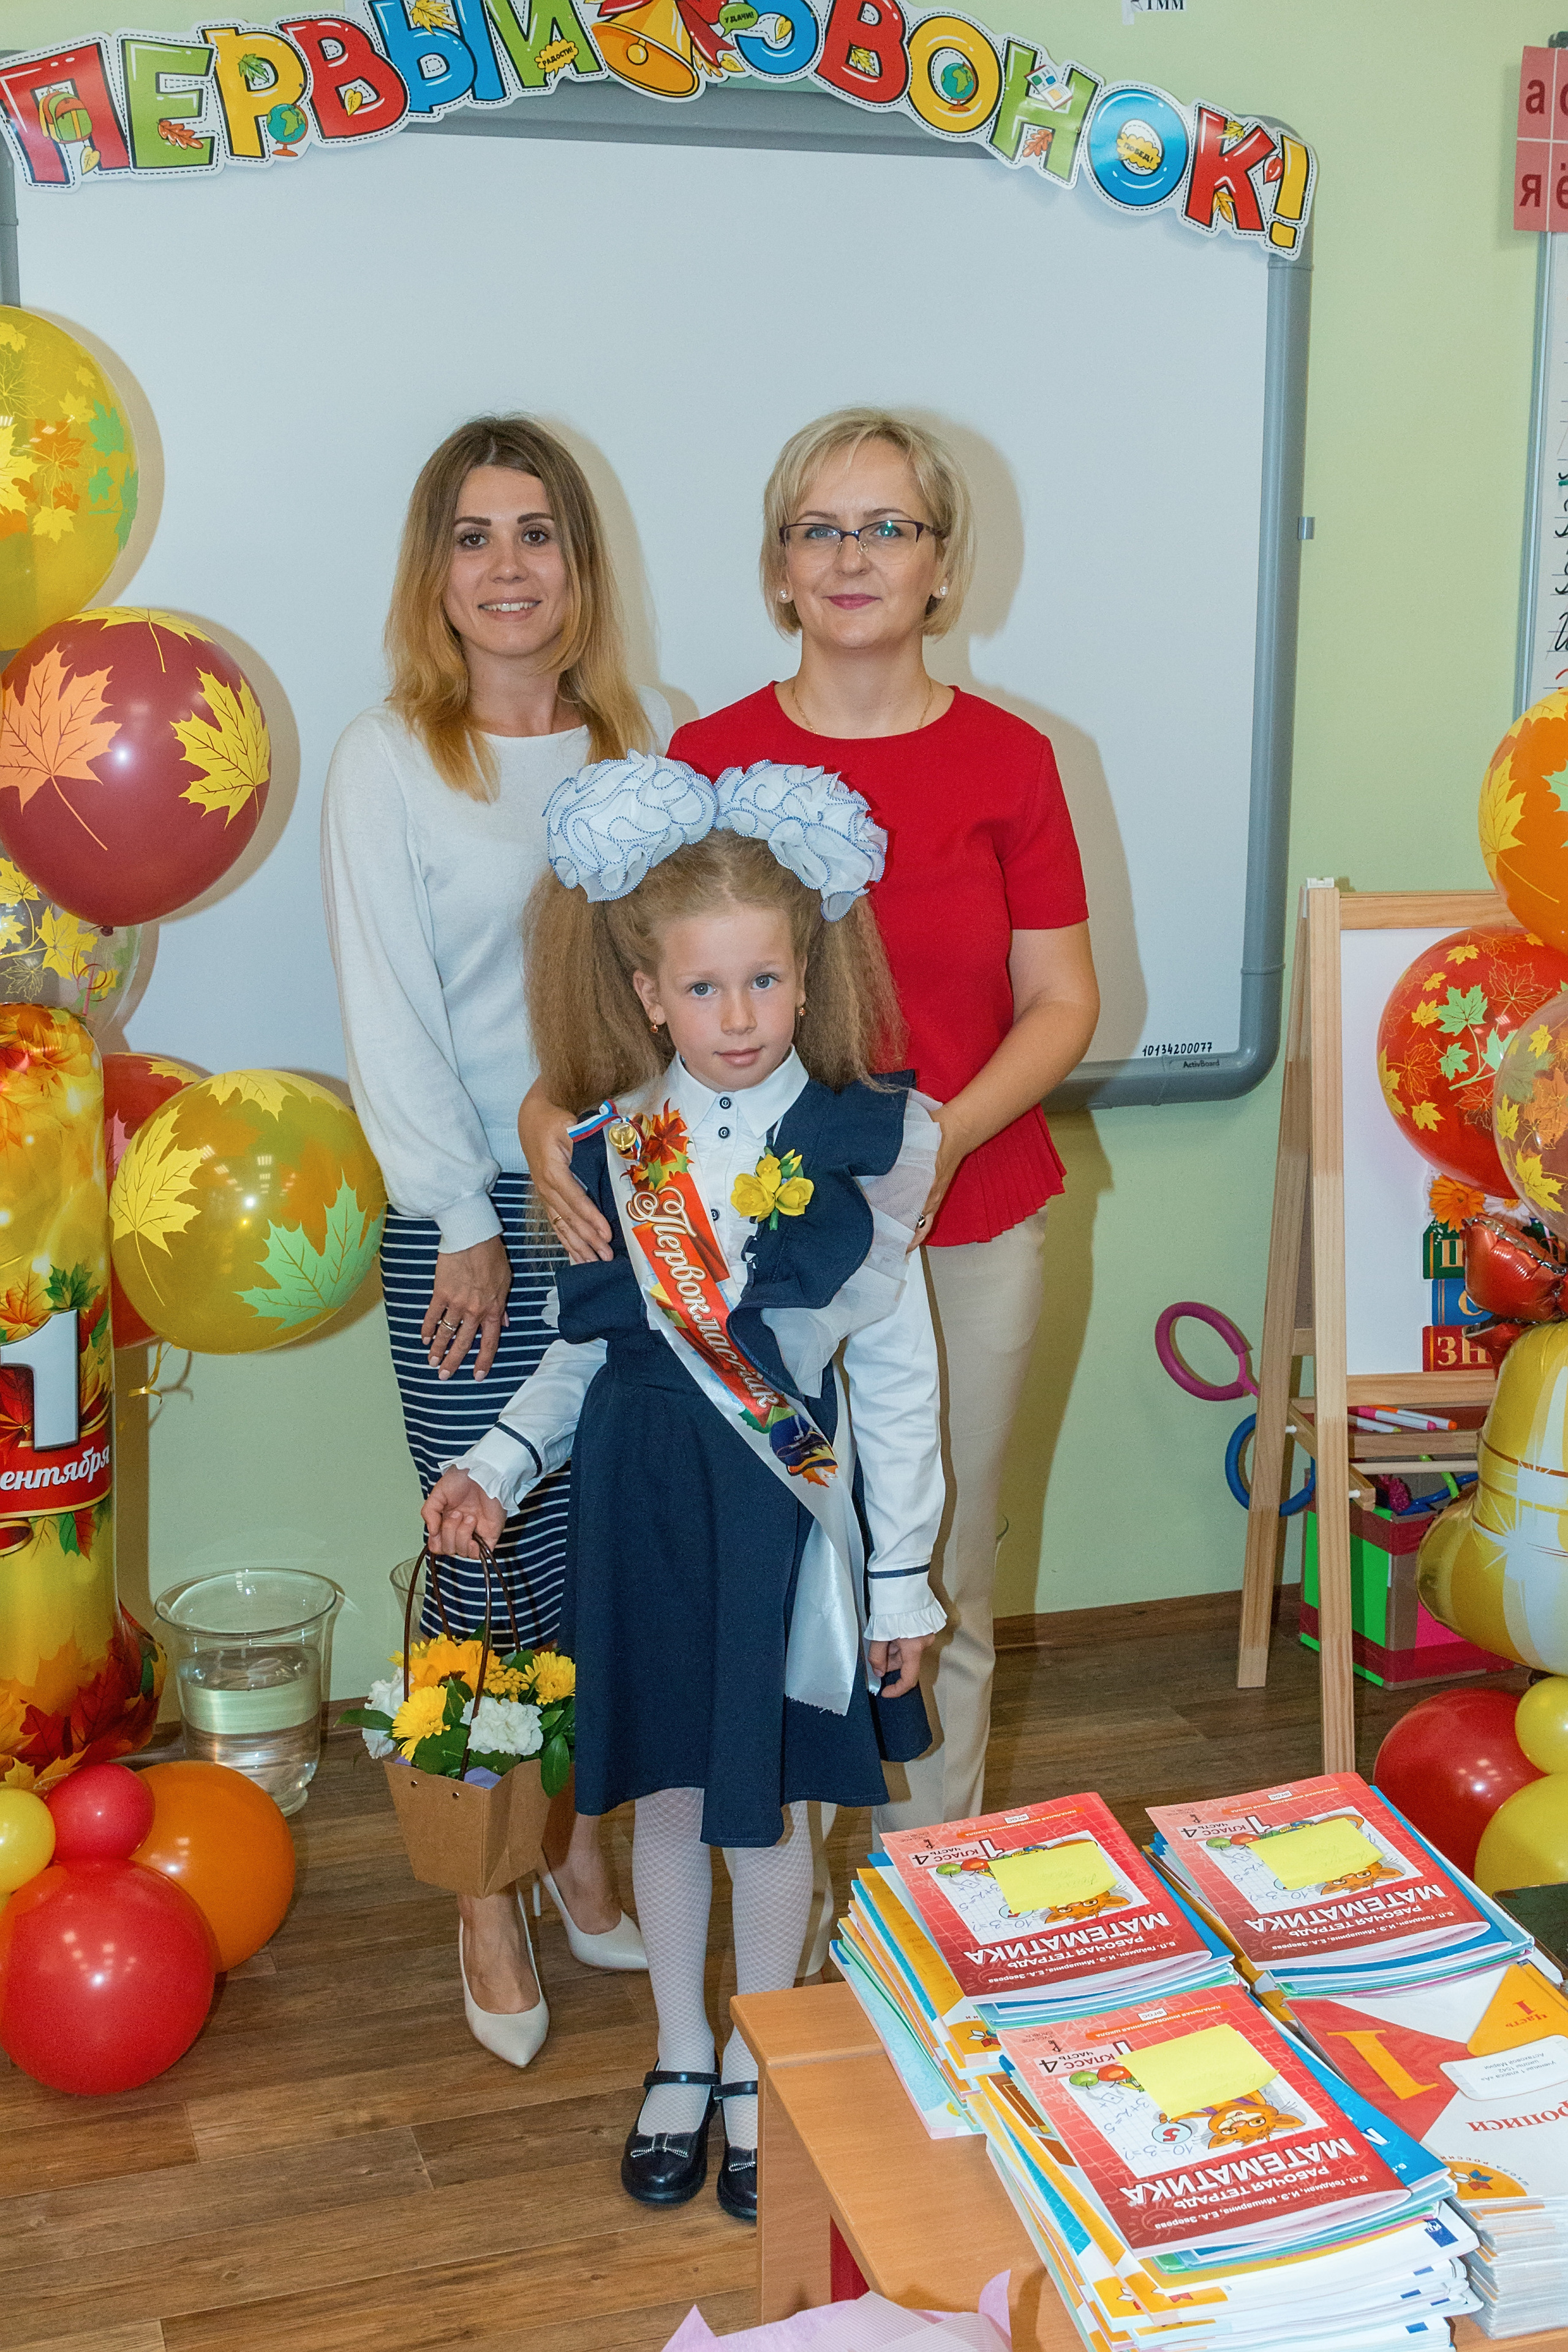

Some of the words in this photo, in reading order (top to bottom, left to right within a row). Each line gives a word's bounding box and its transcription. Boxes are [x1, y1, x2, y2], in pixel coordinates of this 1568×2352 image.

[725, 11, 754, 23] УДАЧИ!
[542, 46, 574, 66] РАДОСТИ!
[734, 0, 1310, 249] ЗВОНОК!
[1124, 142, 1153, 164] ПОБЕД!
[1142, 1042, 1212, 1057] 10134200077
[1183, 1059, 1220, 1068] ActivBoard
[0, 1308, 79, 1451] 1
[1202, 1824, 1247, 1836] КЛАСС
[1245, 1814, 1272, 1834] 1
[1180, 1827, 1197, 1838] 4
[929, 1846, 961, 1855] ЧАСТЬ
[933, 1849, 979, 1862] КЛАСС
[978, 1838, 1005, 1860] 1
[912, 1853, 930, 1866] 4
[1243, 1883, 1448, 1933] МАТЕМАТИКА
[1355, 1904, 1423, 1925] РАБОЧАЯ
[1395, 1914, 1434, 1927] Гейдман,
[1288, 1920, 1355, 1937] ТЕТРАДЬ
[1376, 1923, 1395, 1932] И.Э.
[963, 1911, 1172, 1966] МАТЕМАТИКА
[1308, 1937, 1327, 1946] Е.А.
[1326, 1928, 1376, 1942] Мишарина,
[1076, 1936, 1144, 1956] РАБОЧАЯ
[1157, 1940, 1177, 1950] Б.П.
[1272, 1940, 1308, 1951] Зверева
[1096, 1953, 1116, 1962] И.Э.
[1115, 1946, 1156, 1959] Гейдман,
[1006, 1950, 1075, 1969] ТЕТРАДЬ
[1045, 1958, 1096, 1973] Мишарина,
[987, 1972, 1025, 1984] Зверева
[1027, 1968, 1045, 1978] Е.А.
[1141, 2010, 1164, 2019] ФГОС
[1181, 2004, 1221, 2017] НАЧАЛЬНАЯ
[1121, 2014, 1182, 2032] ИННОВАЦИОННАЯ
[1505, 2015, 1548, 2028] Часть
[1095, 2029, 1121, 2038] ШКОЛА
[1059, 2051, 1094, 2061] ЧАСТЬ
[1063, 2053, 1116, 2070] КЛАСС
[1507, 2052, 1544, 2065] Астаховой
[1039, 2059, 1058, 2073] 4
[1483, 2061, 1508, 2070] Марии
[1515, 2059, 1540, 2068] школы
[1526, 2060, 1556, 2071] ученицы
[1495, 2070, 1520, 2078] класса
[1440, 2155, 1489, 2165] РОССИИ
[1118, 2136, 1359, 2206] МАТЕМАТИКА
[1496, 2165, 1529, 2187] ШКОЛА
[1250, 2165, 1330, 2193] РАБОЧАЯ
[1346, 2175, 1369, 2185] Б.П.
[1298, 2179, 1346, 2195] Гейдман,
[1172, 2184, 1250, 2210] ТЕТРАДЬ
[1277, 2190, 1300, 2202] И.Э.
[1219, 2196, 1277, 2215] Мишарина,
[1197, 2209, 1219, 2221] Е.А.
[1153, 2216, 1197, 2230] Зверева
